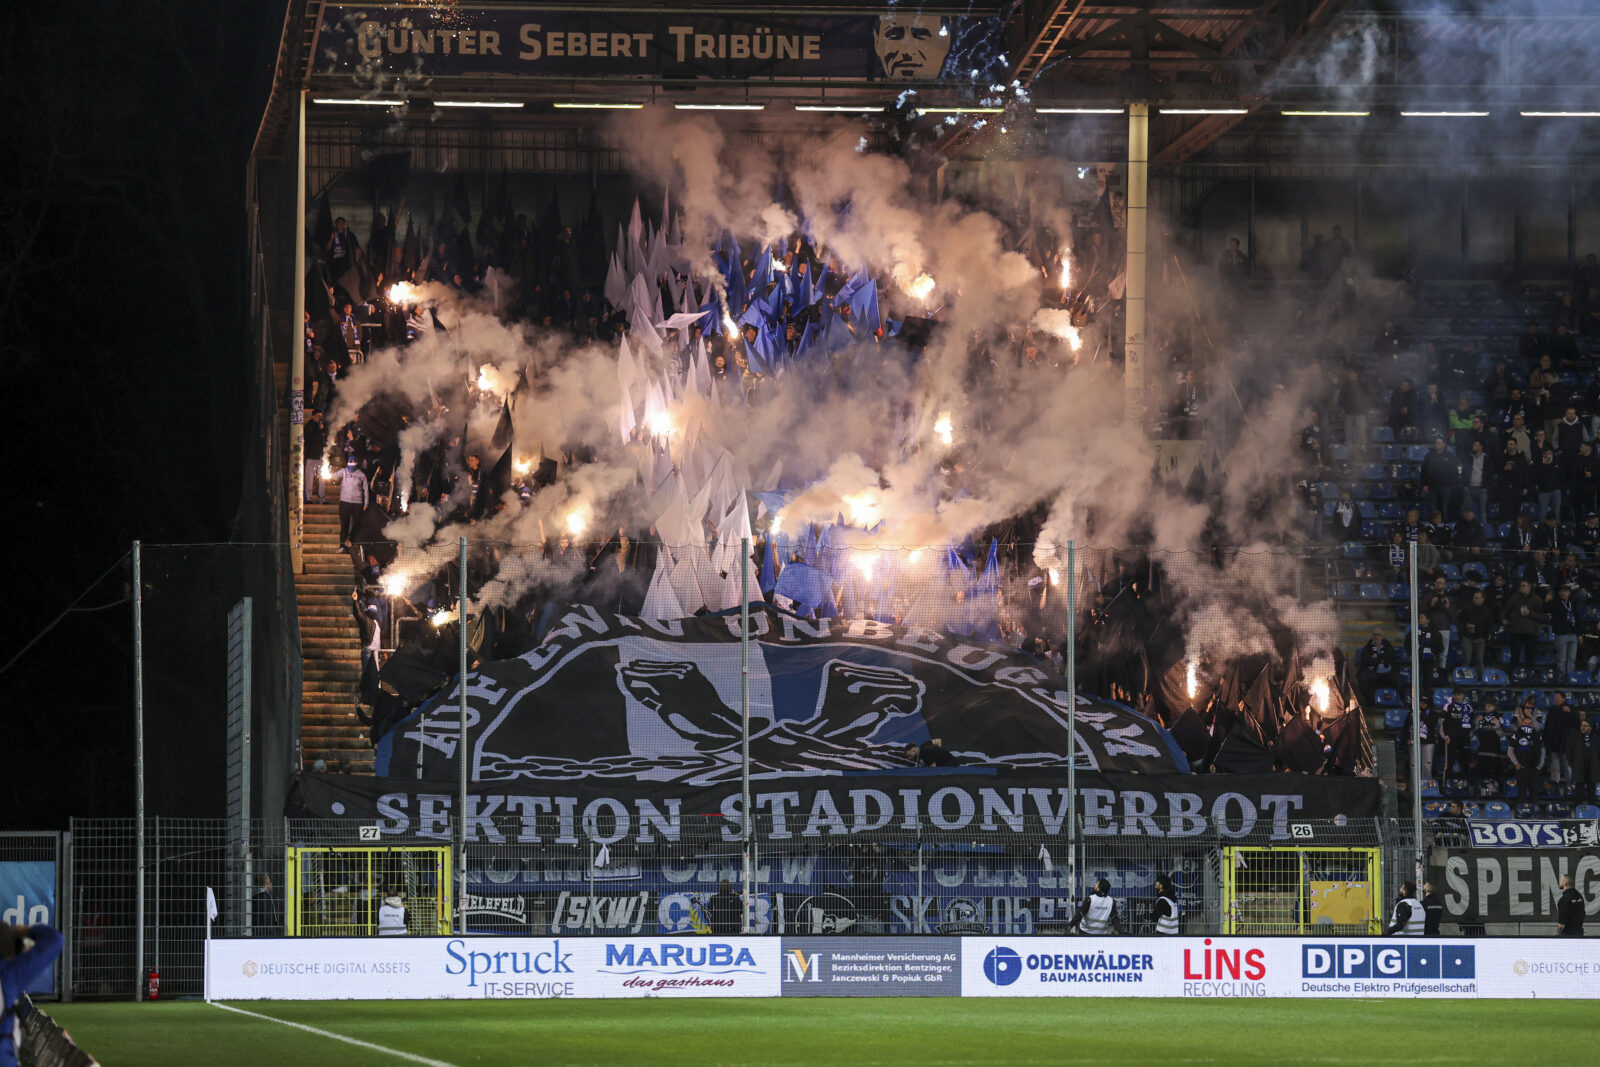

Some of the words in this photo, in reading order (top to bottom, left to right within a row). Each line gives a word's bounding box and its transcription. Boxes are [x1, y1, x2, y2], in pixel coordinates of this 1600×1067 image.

[357, 20, 502, 58] GÜNTER
[519, 23, 653, 61] SEBERT
[668, 26, 821, 62] TRIBÜNE
[404, 670, 507, 760] AUF
[376, 793, 682, 844] SEKTION
[720, 786, 1303, 841] STADIONVERBOT
[362, 828, 378, 838] 27
[1294, 826, 1311, 836] 26
[1470, 823, 1563, 847] BOYS
[1444, 855, 1600, 916] SPENG
[458, 893, 525, 916] IELEFELD
[551, 891, 649, 934] [SKW]
[445, 940, 574, 987] Spruck
[832, 953, 885, 961] Mannheimer
[887, 953, 941, 963] Versicherung
[943, 953, 957, 961] AG
[1026, 950, 1154, 970] ODENWÄLDER
[1306, 948, 1402, 975] DPG
[260, 962, 320, 975] DEUTSCHE
[324, 962, 367, 974] DIGITAL
[371, 962, 411, 974] ASSETS
[832, 963, 902, 972] Bezirksdirektion
[904, 963, 953, 974] Bentzinger,
[1530, 962, 1590, 975] DEUTSCHE
[622, 975, 654, 988] das
[652, 975, 735, 991] gasthaus
[832, 974, 880, 982] Janczewski
[882, 974, 889, 982] &
[892, 974, 922, 984] Popiuk
[924, 974, 943, 982] GbR
[1040, 972, 1143, 983] BAUMASCHINEN
[483, 982, 575, 996] IT-SERVICE
[1183, 982, 1266, 997] RECYCLING
[1302, 982, 1351, 993] Deutsche
[1354, 982, 1390, 993] Elektro
[1393, 982, 1476, 994] Prüfgesellschaft
